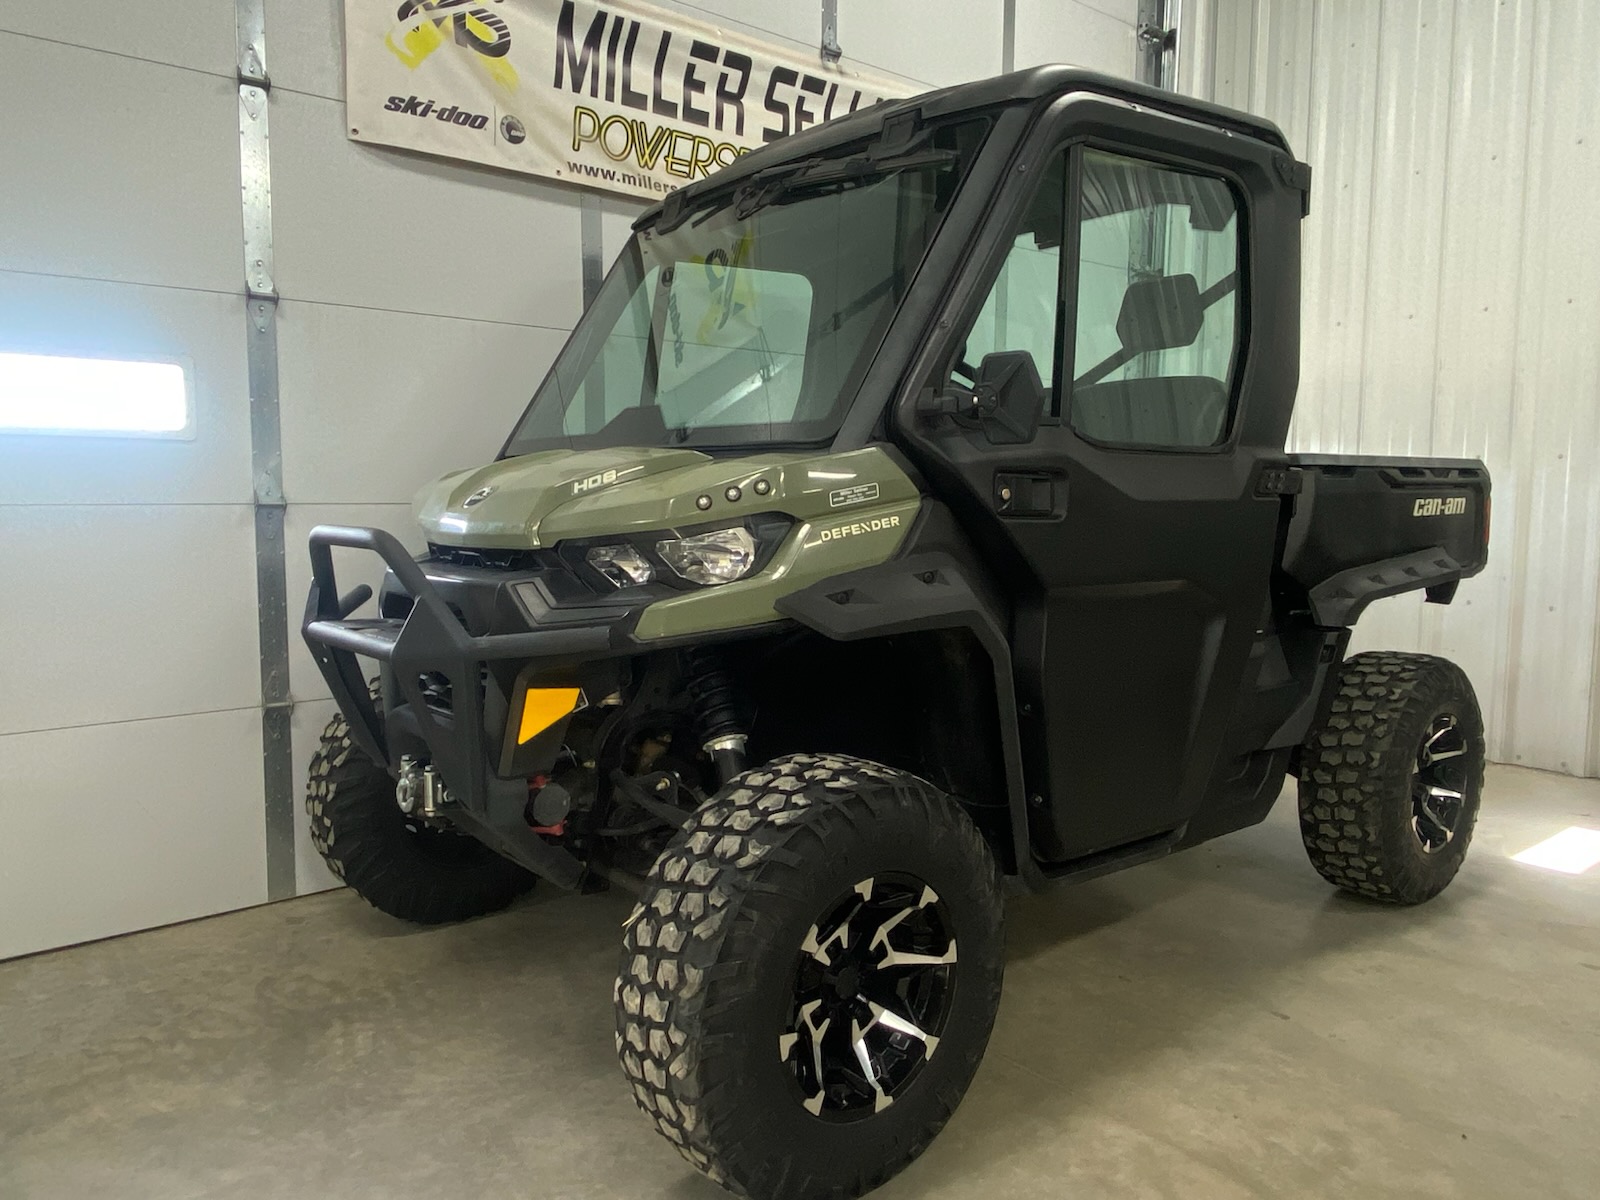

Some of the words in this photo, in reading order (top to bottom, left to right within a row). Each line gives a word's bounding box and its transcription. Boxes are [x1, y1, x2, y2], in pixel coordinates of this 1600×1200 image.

[553, 0, 753, 136] MILLER
[384, 95, 489, 130] ski-doo
[572, 105, 753, 179] POWERS
[820, 516, 900, 541] DEFENDER
